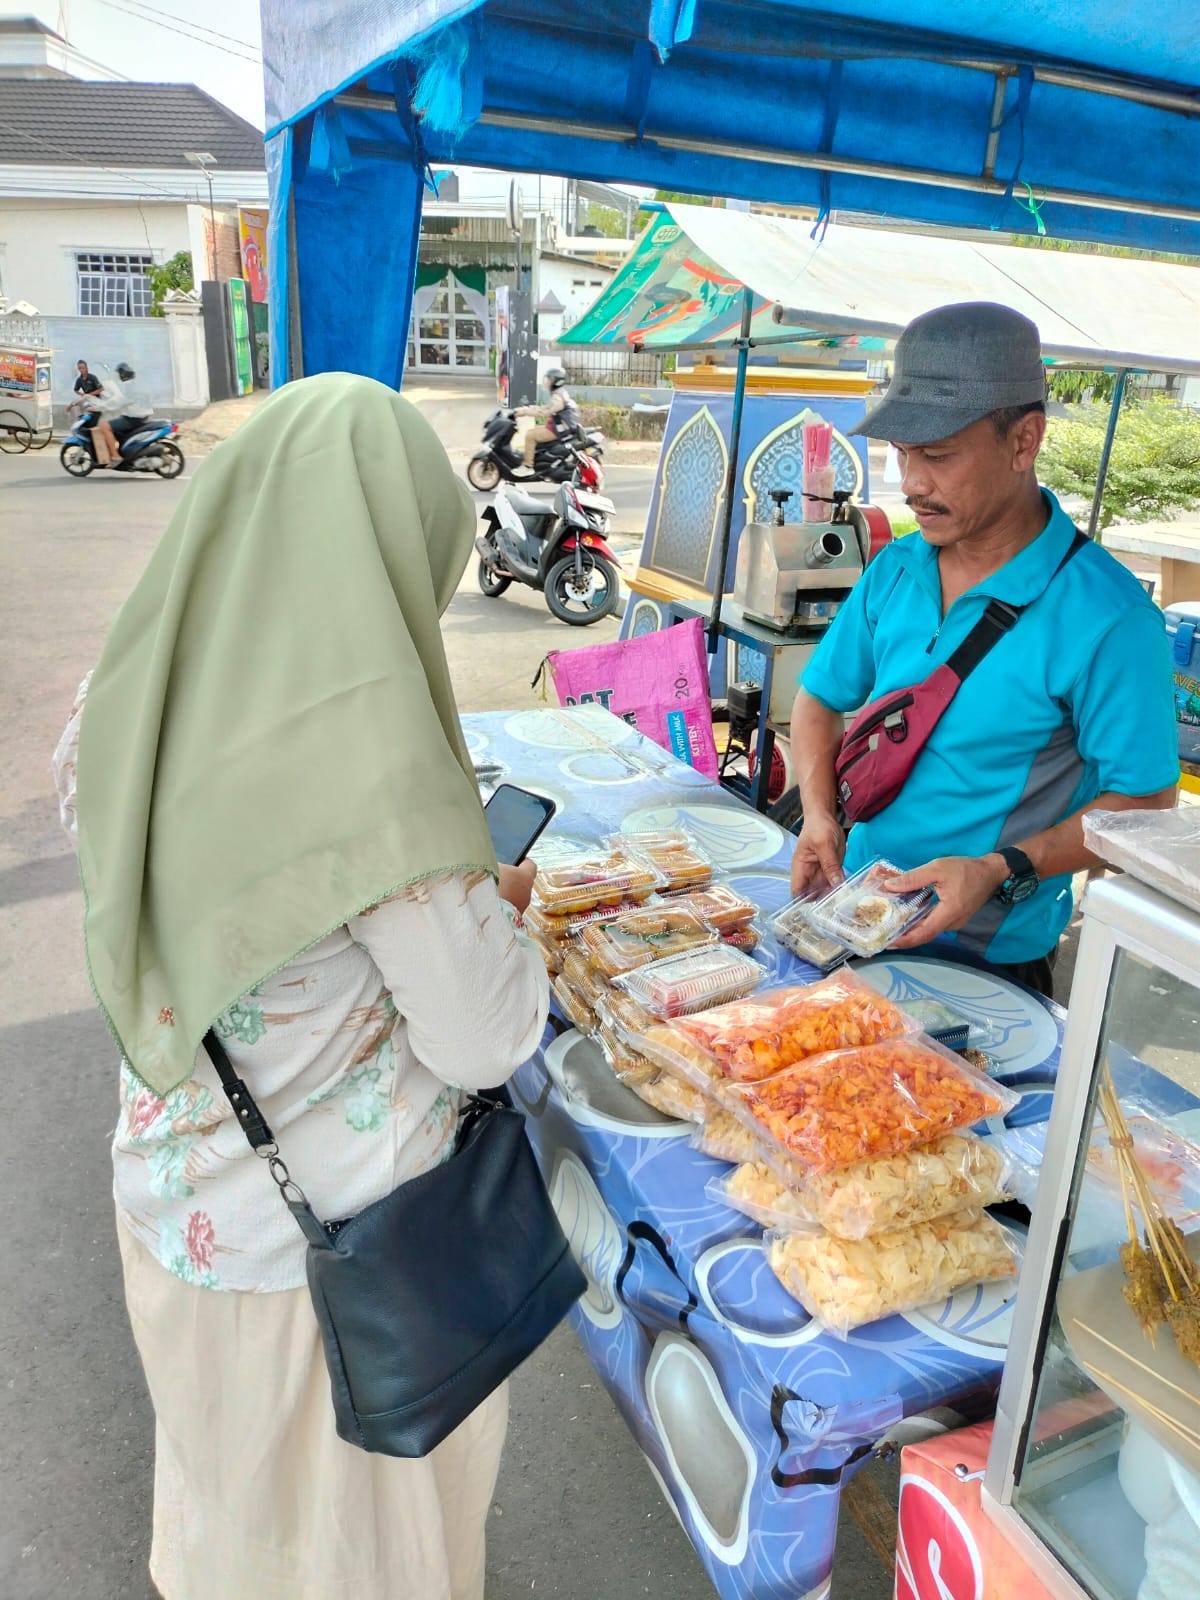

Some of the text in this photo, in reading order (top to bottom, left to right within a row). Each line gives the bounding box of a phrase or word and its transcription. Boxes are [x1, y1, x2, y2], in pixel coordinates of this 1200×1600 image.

[674, 678, 690, 699] 20
[676, 733, 686, 752] WITH
[688, 725, 700, 757] KITTEN
